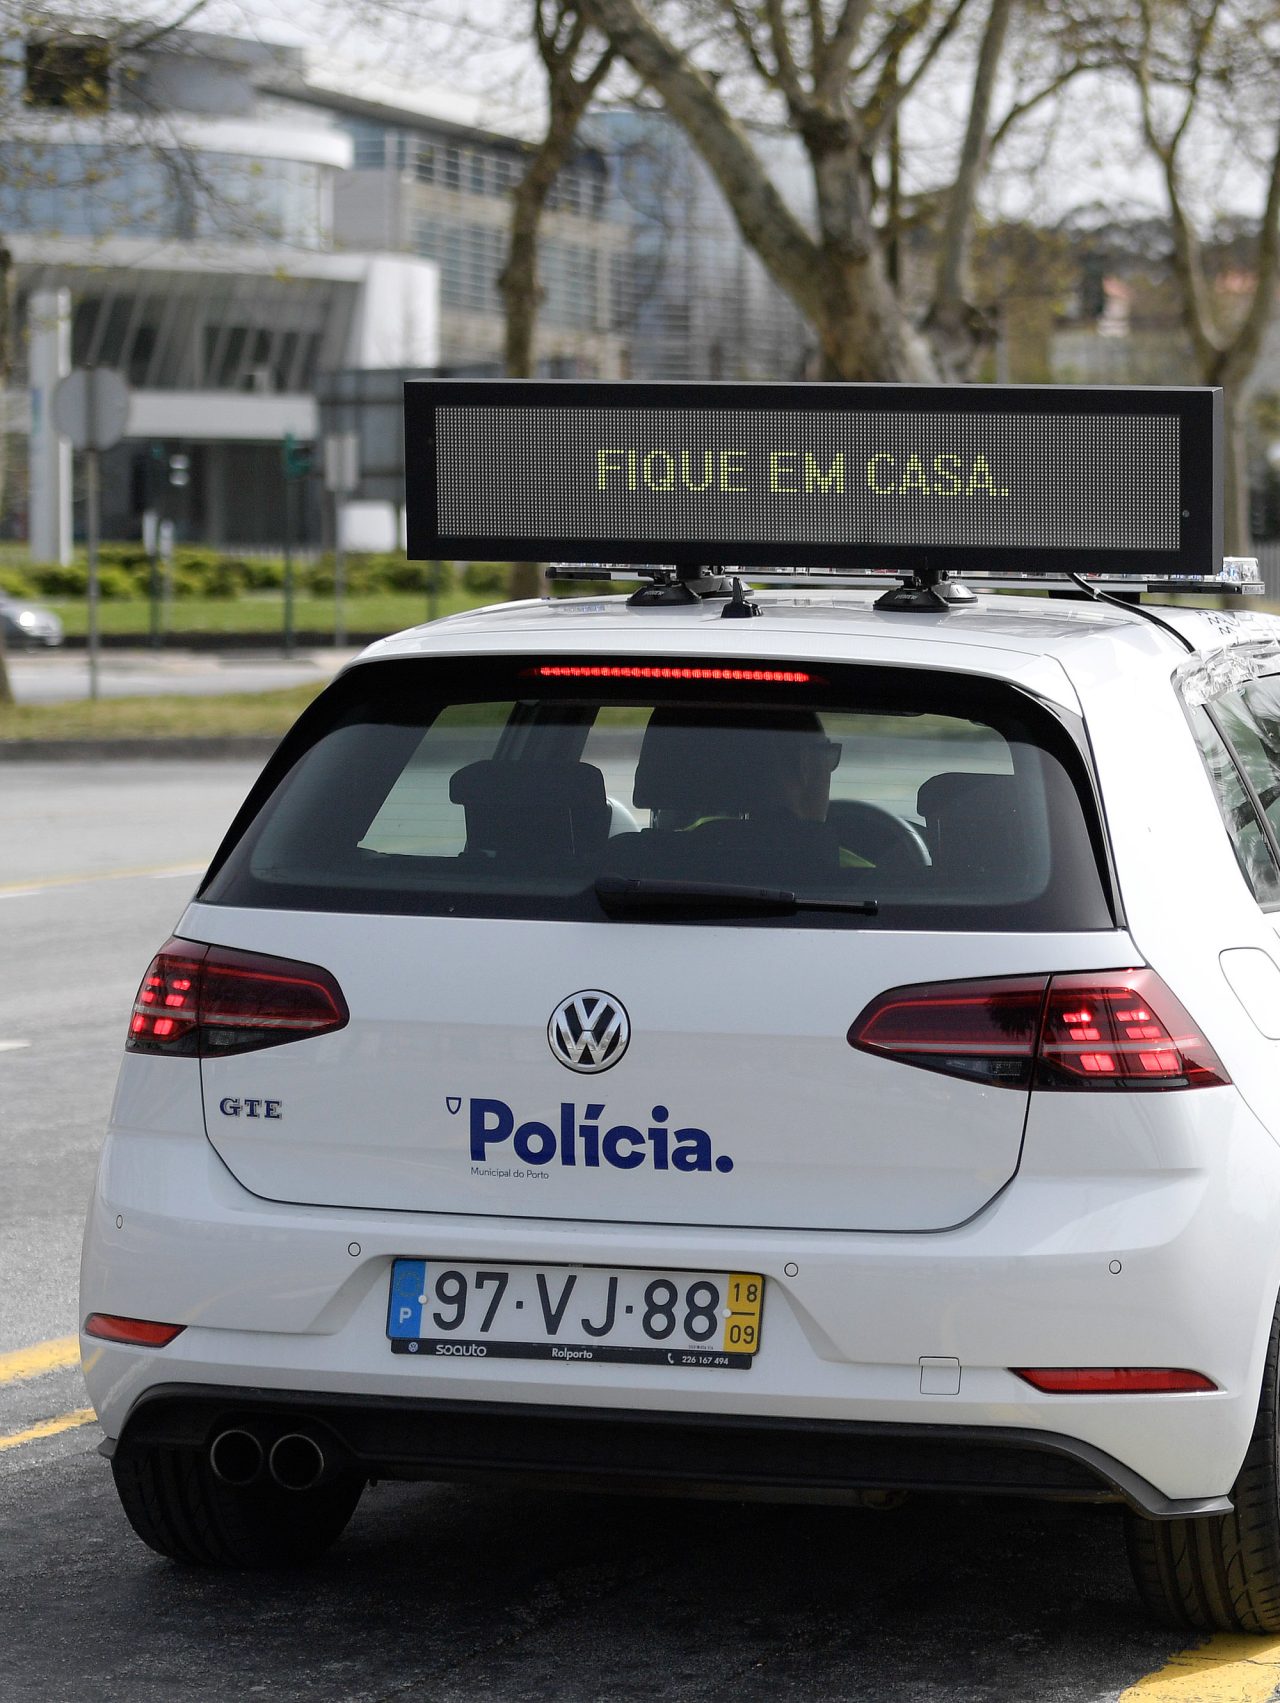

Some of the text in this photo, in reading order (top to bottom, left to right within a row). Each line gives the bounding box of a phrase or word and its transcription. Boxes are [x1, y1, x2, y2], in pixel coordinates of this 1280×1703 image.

[597, 448, 1009, 497] FIQUE EM CASA.
[219, 1097, 283, 1120] GTE
[470, 1098, 734, 1174] Polícia.
[470, 1167, 550, 1179] Municipal do Porto
[733, 1283, 757, 1303] 18
[399, 1308, 412, 1323] P
[729, 1324, 755, 1345] 09
[551, 1347, 593, 1360] Rolporto
[682, 1356, 696, 1364] 226
[714, 1357, 729, 1365] 494
